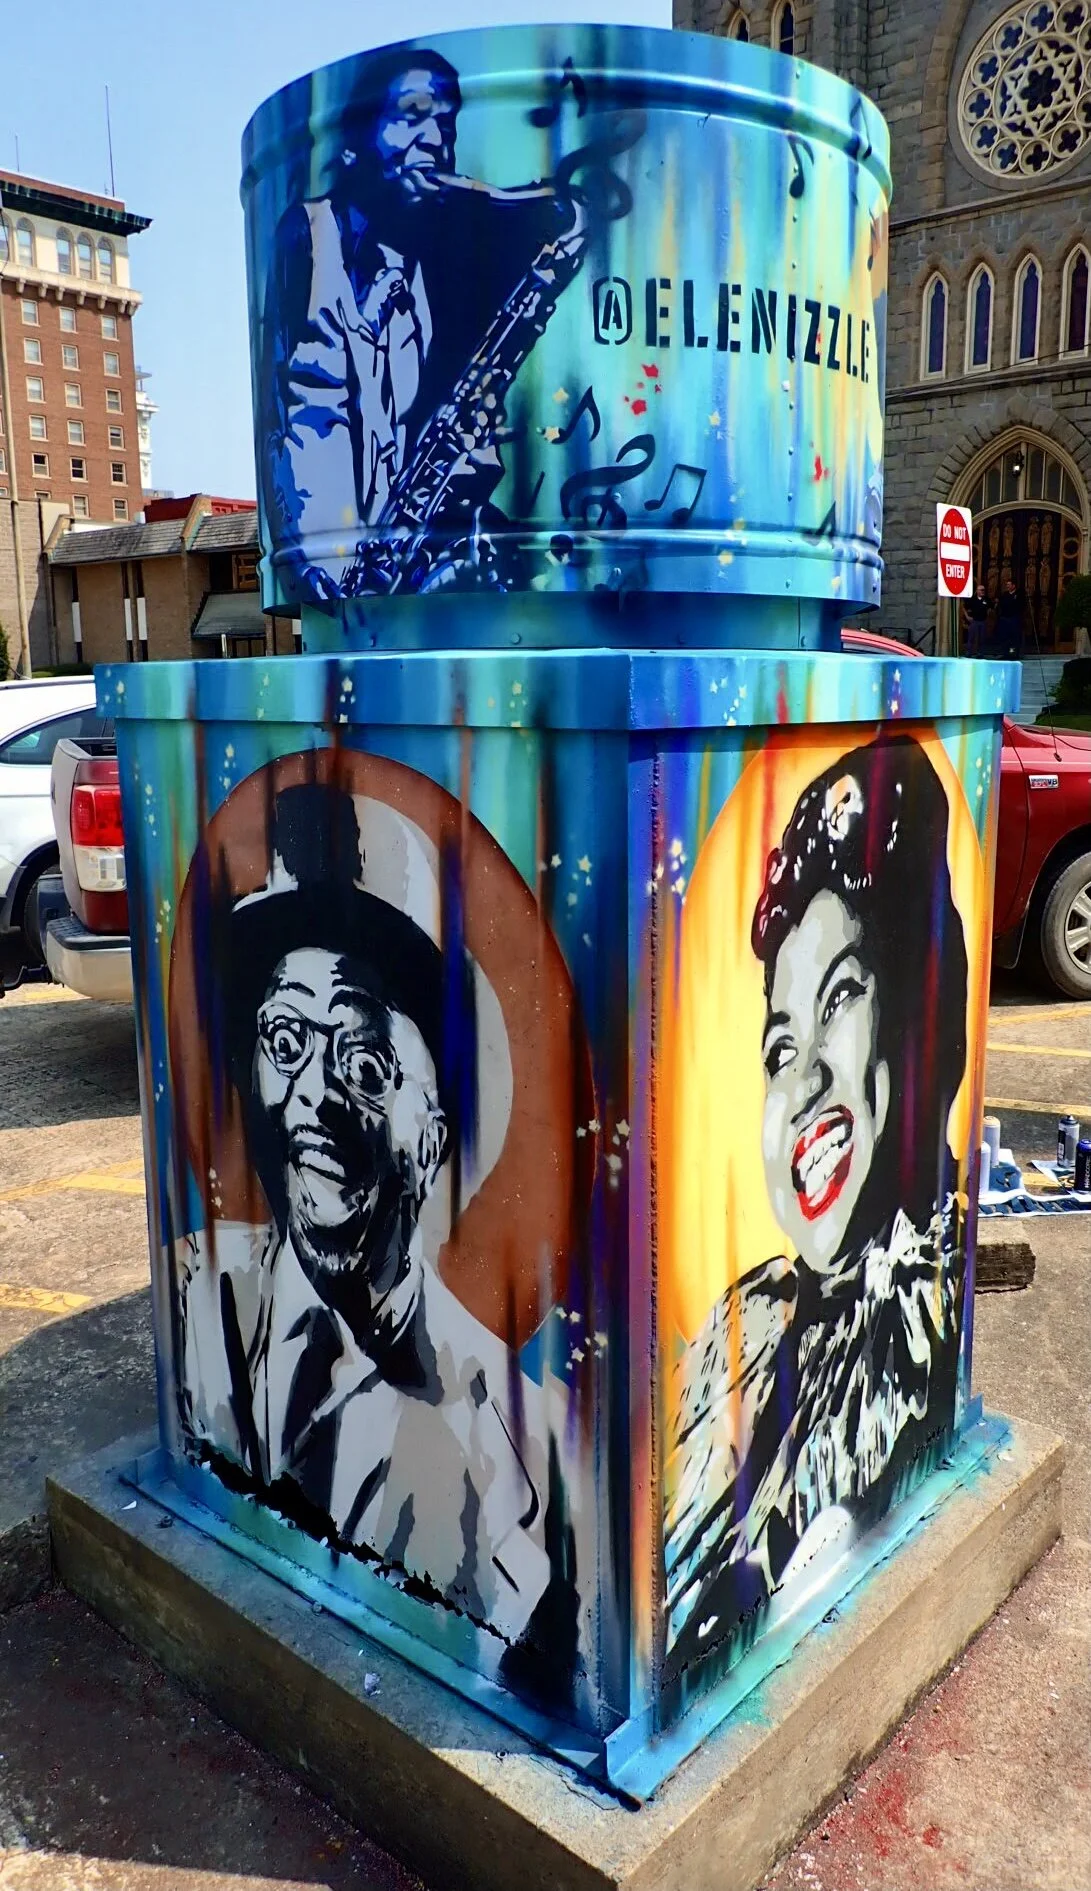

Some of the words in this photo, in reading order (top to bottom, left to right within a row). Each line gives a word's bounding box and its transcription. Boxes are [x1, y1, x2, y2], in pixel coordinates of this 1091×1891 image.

[592, 276, 870, 383] @ELENIZZLE
[943, 523, 951, 538] DO
[954, 525, 967, 540] NOT
[946, 564, 965, 579] ENTER
